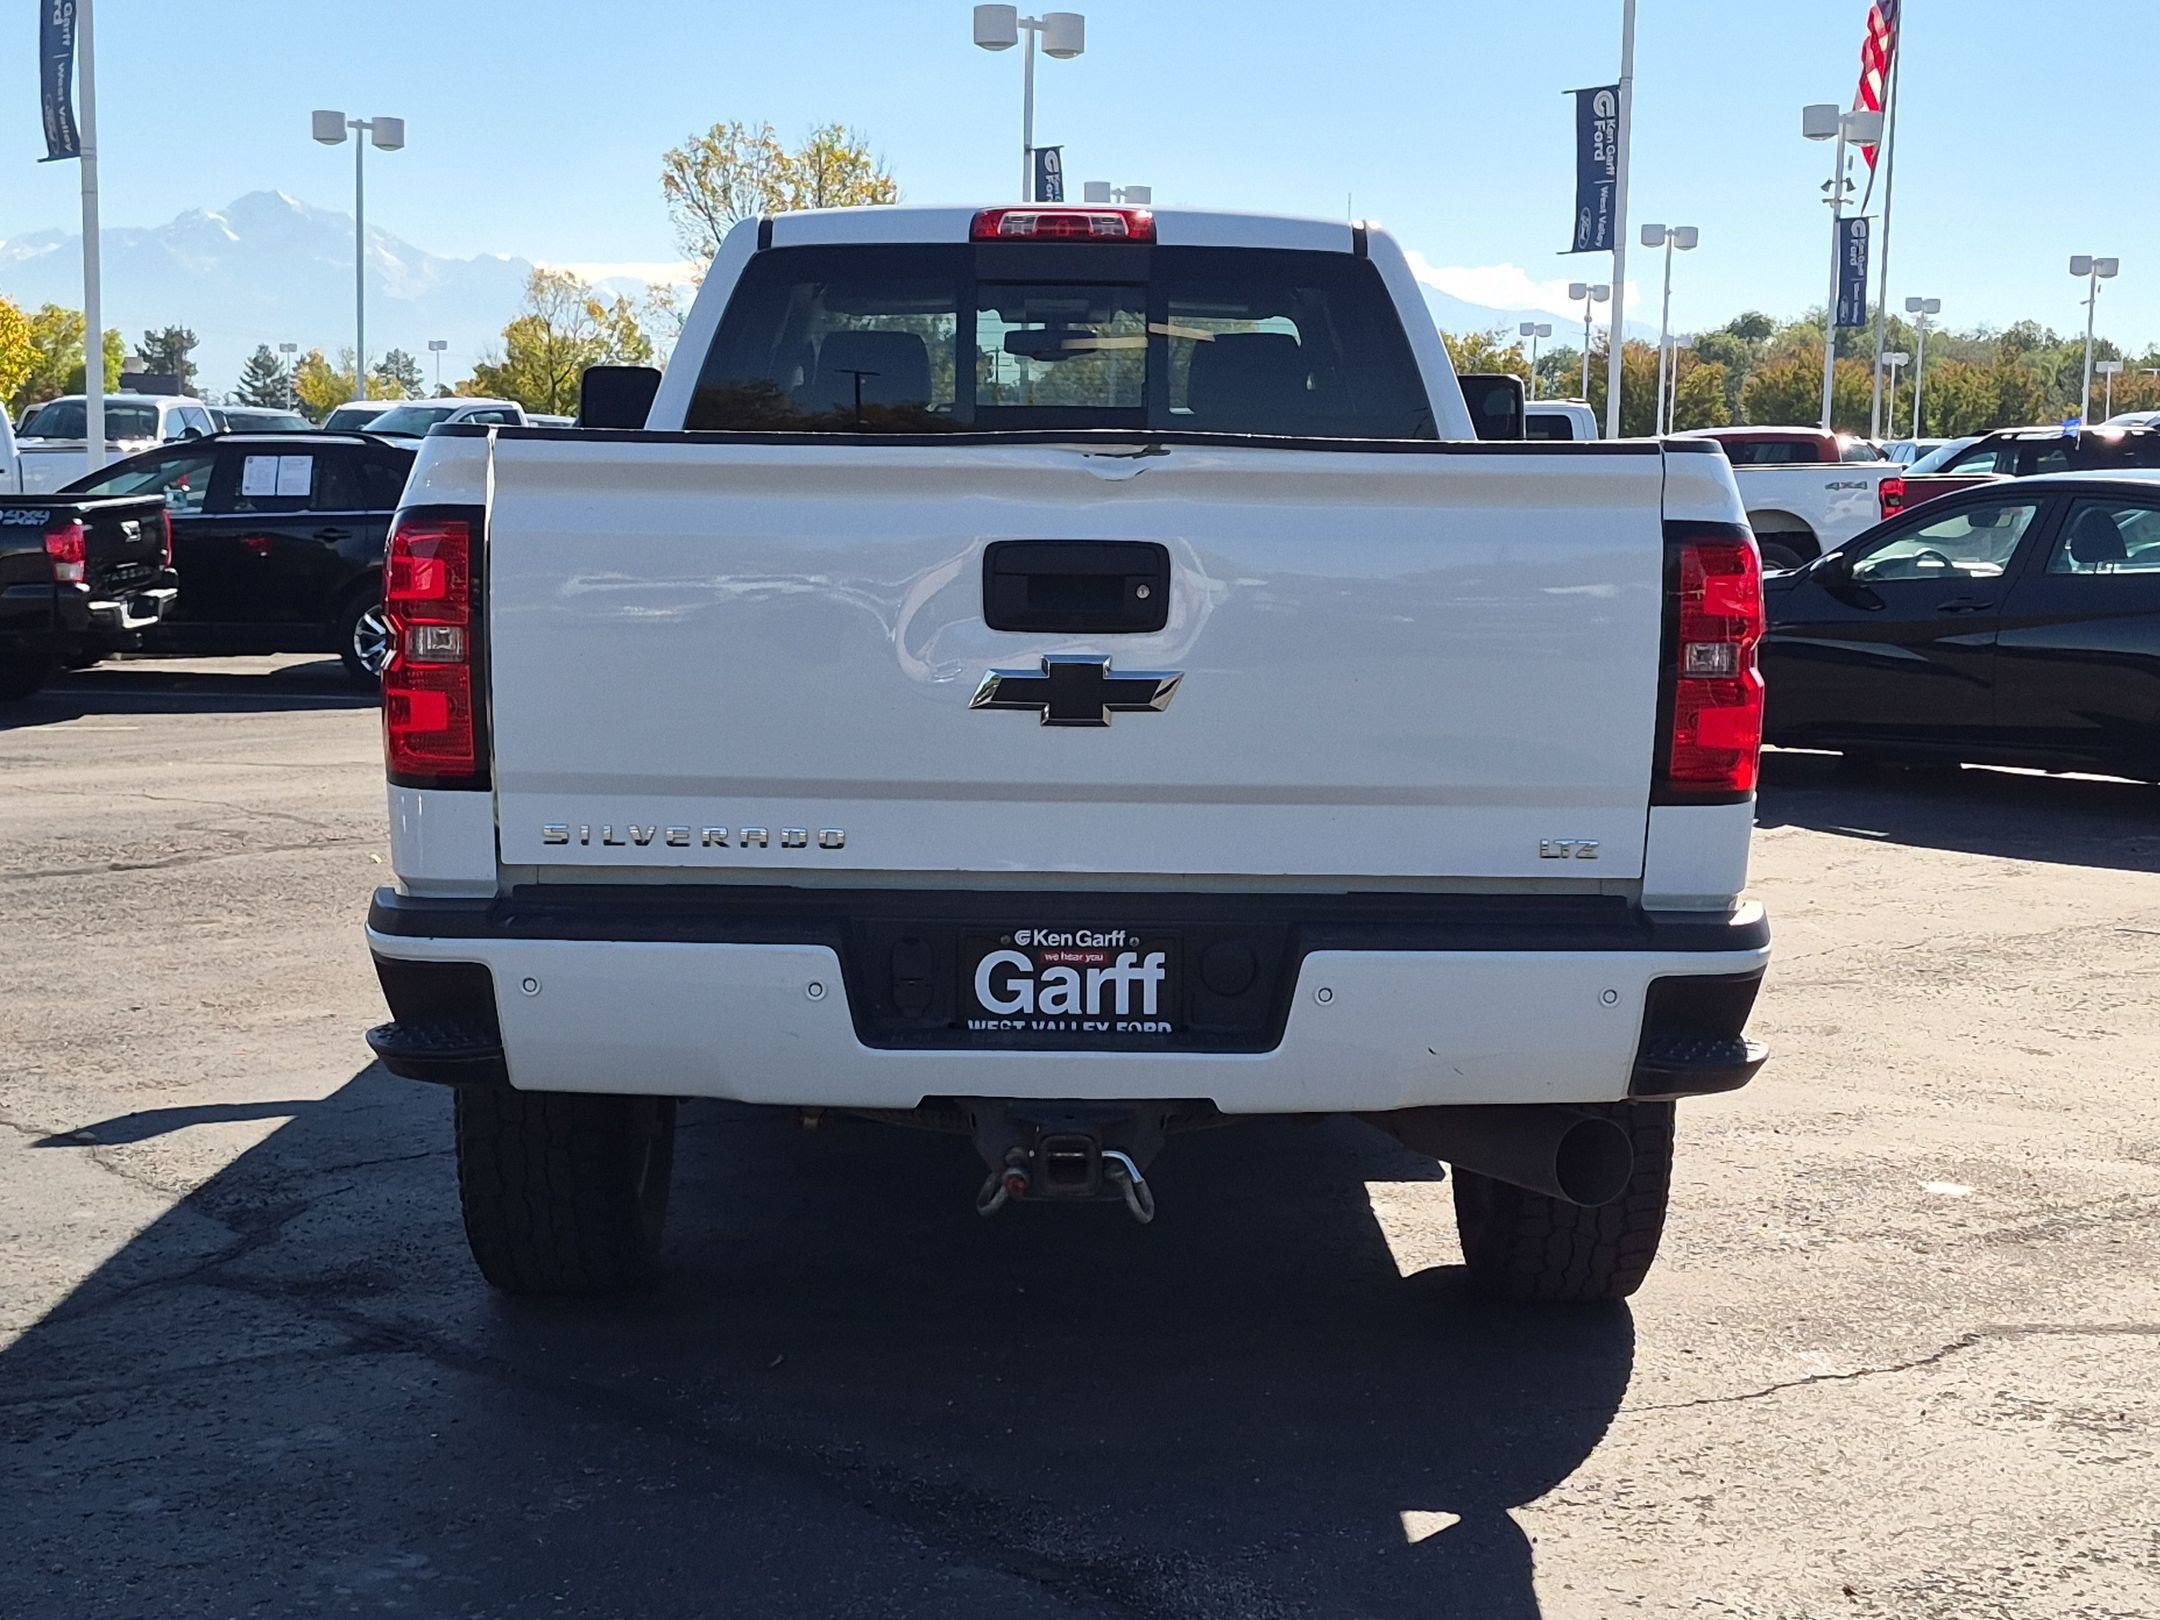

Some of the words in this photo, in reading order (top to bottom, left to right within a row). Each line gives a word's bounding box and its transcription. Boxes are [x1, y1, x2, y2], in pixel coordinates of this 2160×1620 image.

[57, 62, 65, 101] West
[59, 106, 72, 152] Valley
[1593, 120, 1606, 161] Ford
[1605, 119, 1616, 144] Ken
[1605, 145, 1616, 176] Garff
[1045, 175, 1053, 202] For
[1599, 186, 1609, 214] West
[1594, 215, 1607, 248] Valley
[1850, 239, 1858, 266] Ford
[543, 823, 846, 850] SILVERADO
[1540, 839, 1599, 859] LTZ
[1033, 929, 1073, 947] Ken
[1076, 930, 1126, 947] Garff
[1044, 953, 1059, 961] we
[1061, 951, 1083, 961] hear
[1085, 954, 1103, 963] you
[974, 949, 1166, 1015] Garff
